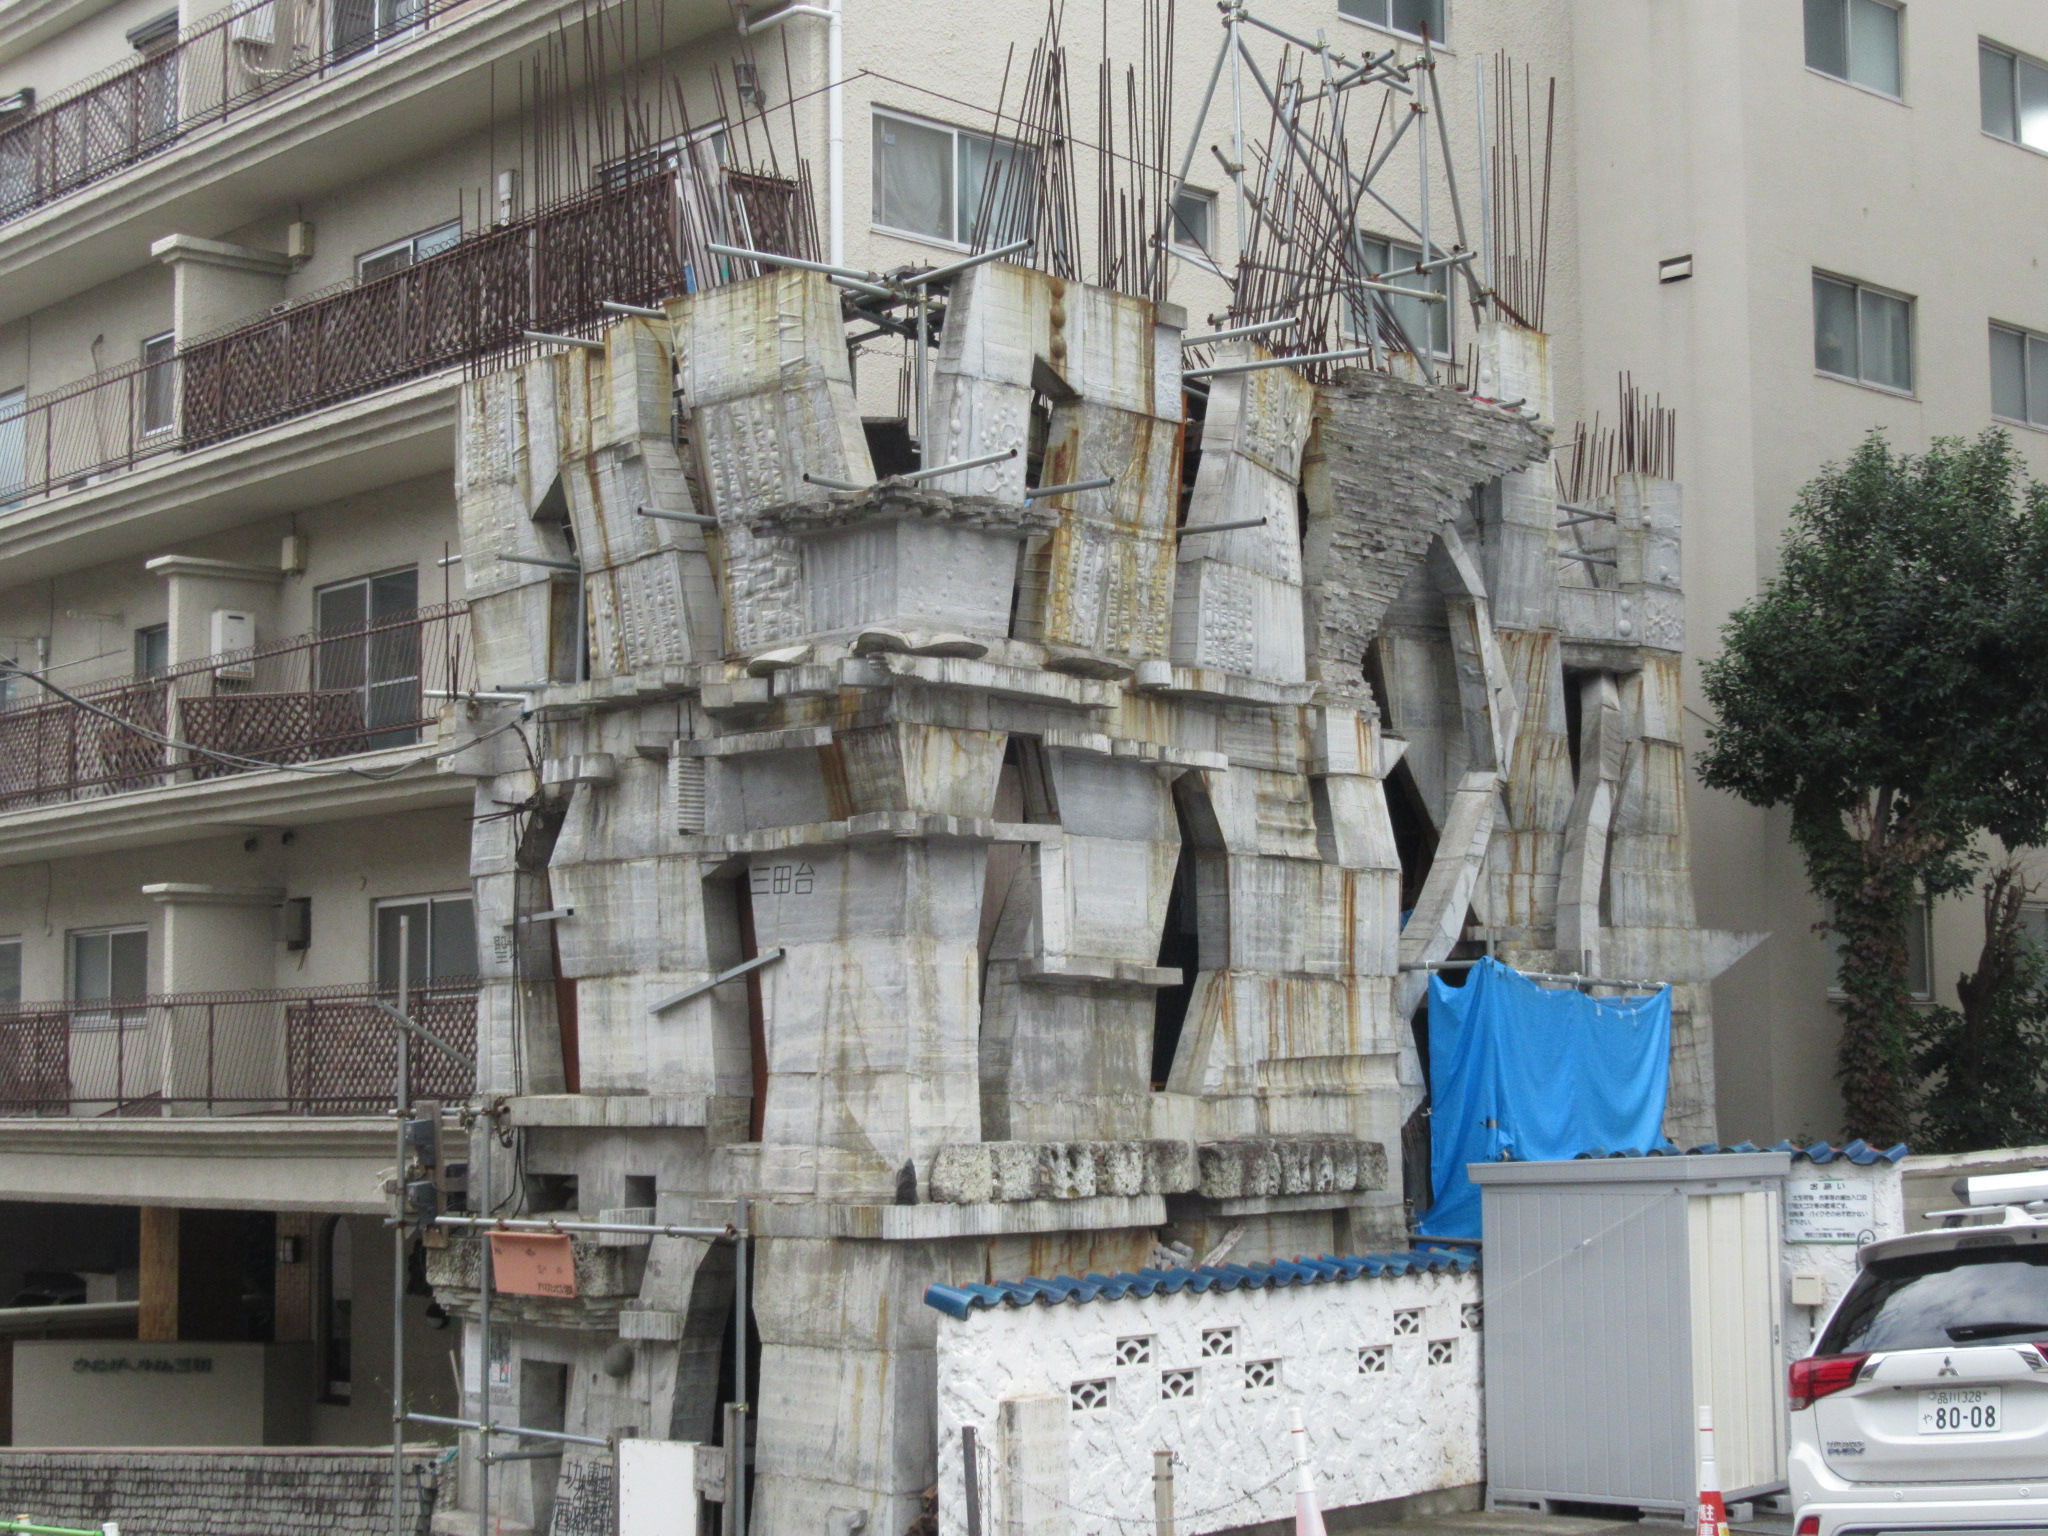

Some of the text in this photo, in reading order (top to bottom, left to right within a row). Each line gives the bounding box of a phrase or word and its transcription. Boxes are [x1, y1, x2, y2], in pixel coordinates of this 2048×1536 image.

[751, 861, 815, 895] 三田台
[1923, 1405, 1996, 1429] や 80-08
